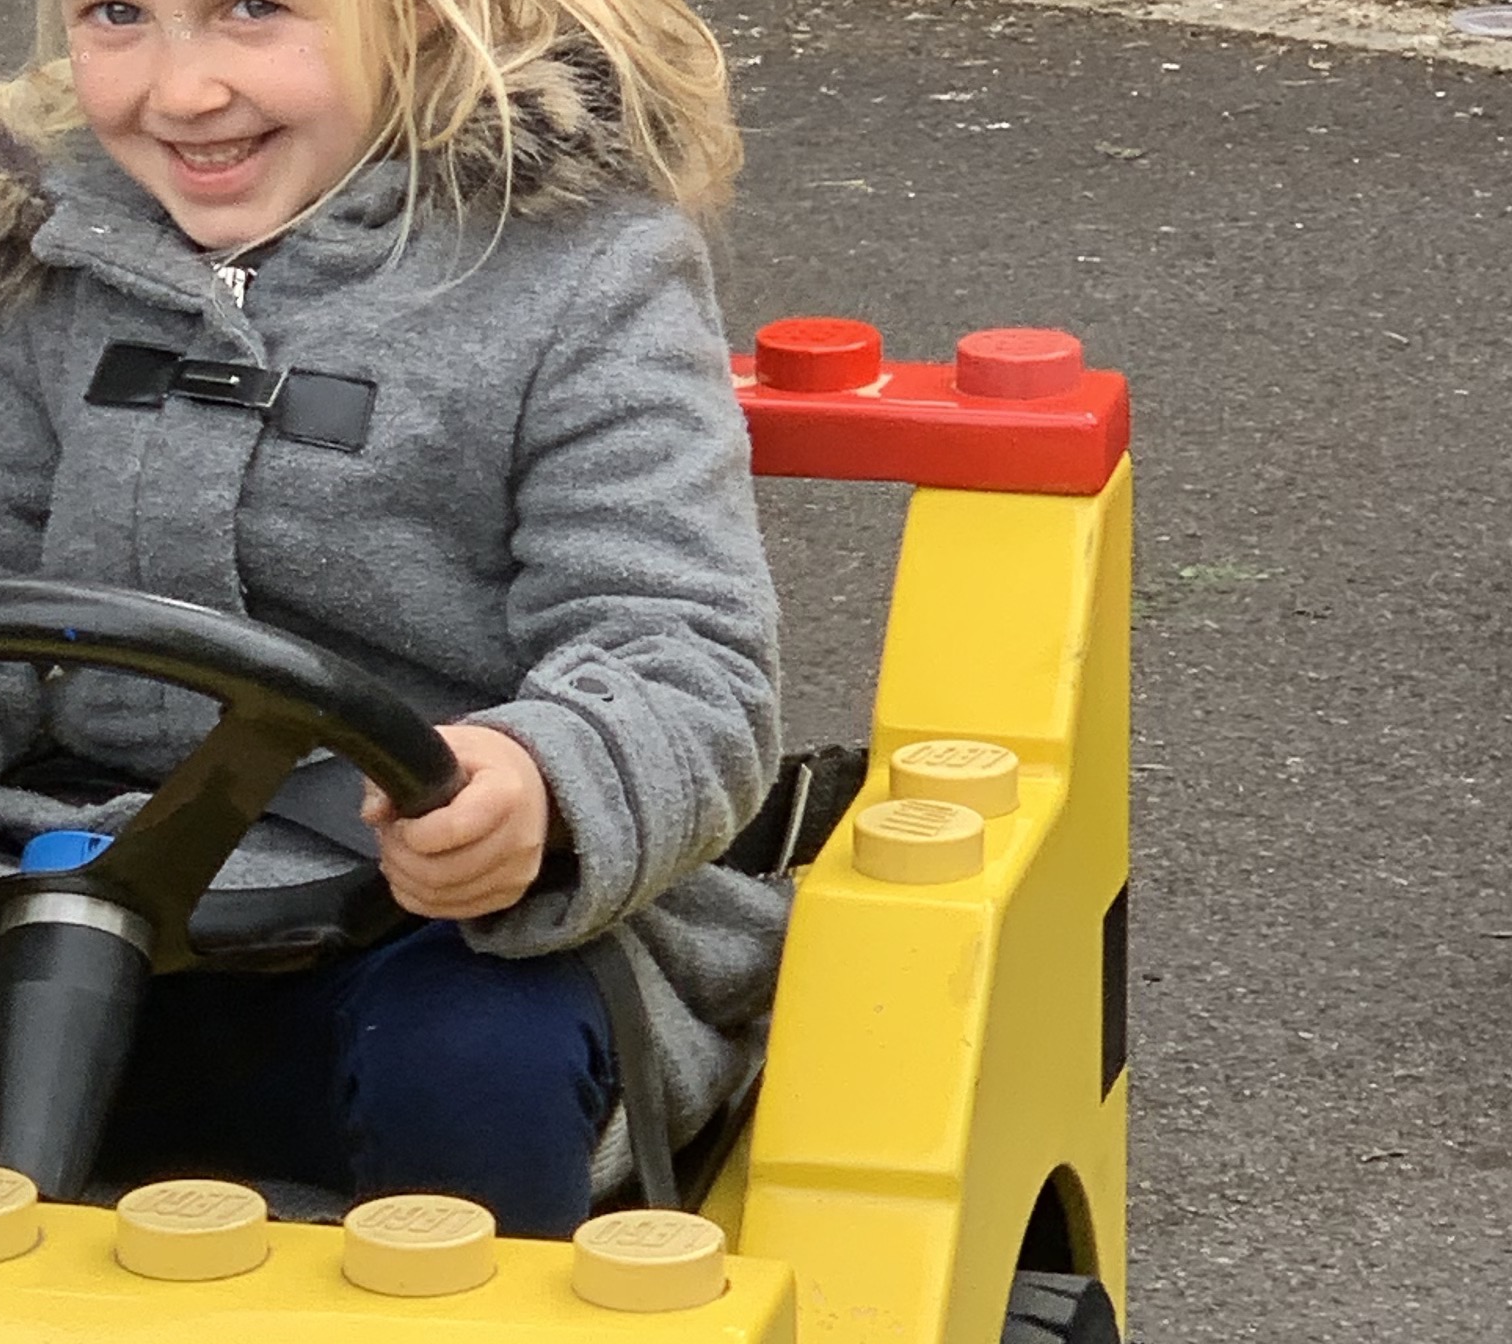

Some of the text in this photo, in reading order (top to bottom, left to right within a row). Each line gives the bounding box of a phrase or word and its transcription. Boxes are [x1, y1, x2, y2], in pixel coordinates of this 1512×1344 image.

[900, 745, 1009, 769] LEGO
[125, 1189, 254, 1218] LEGO
[355, 1204, 482, 1235] LEGO
[591, 1220, 711, 1249] LEGO
